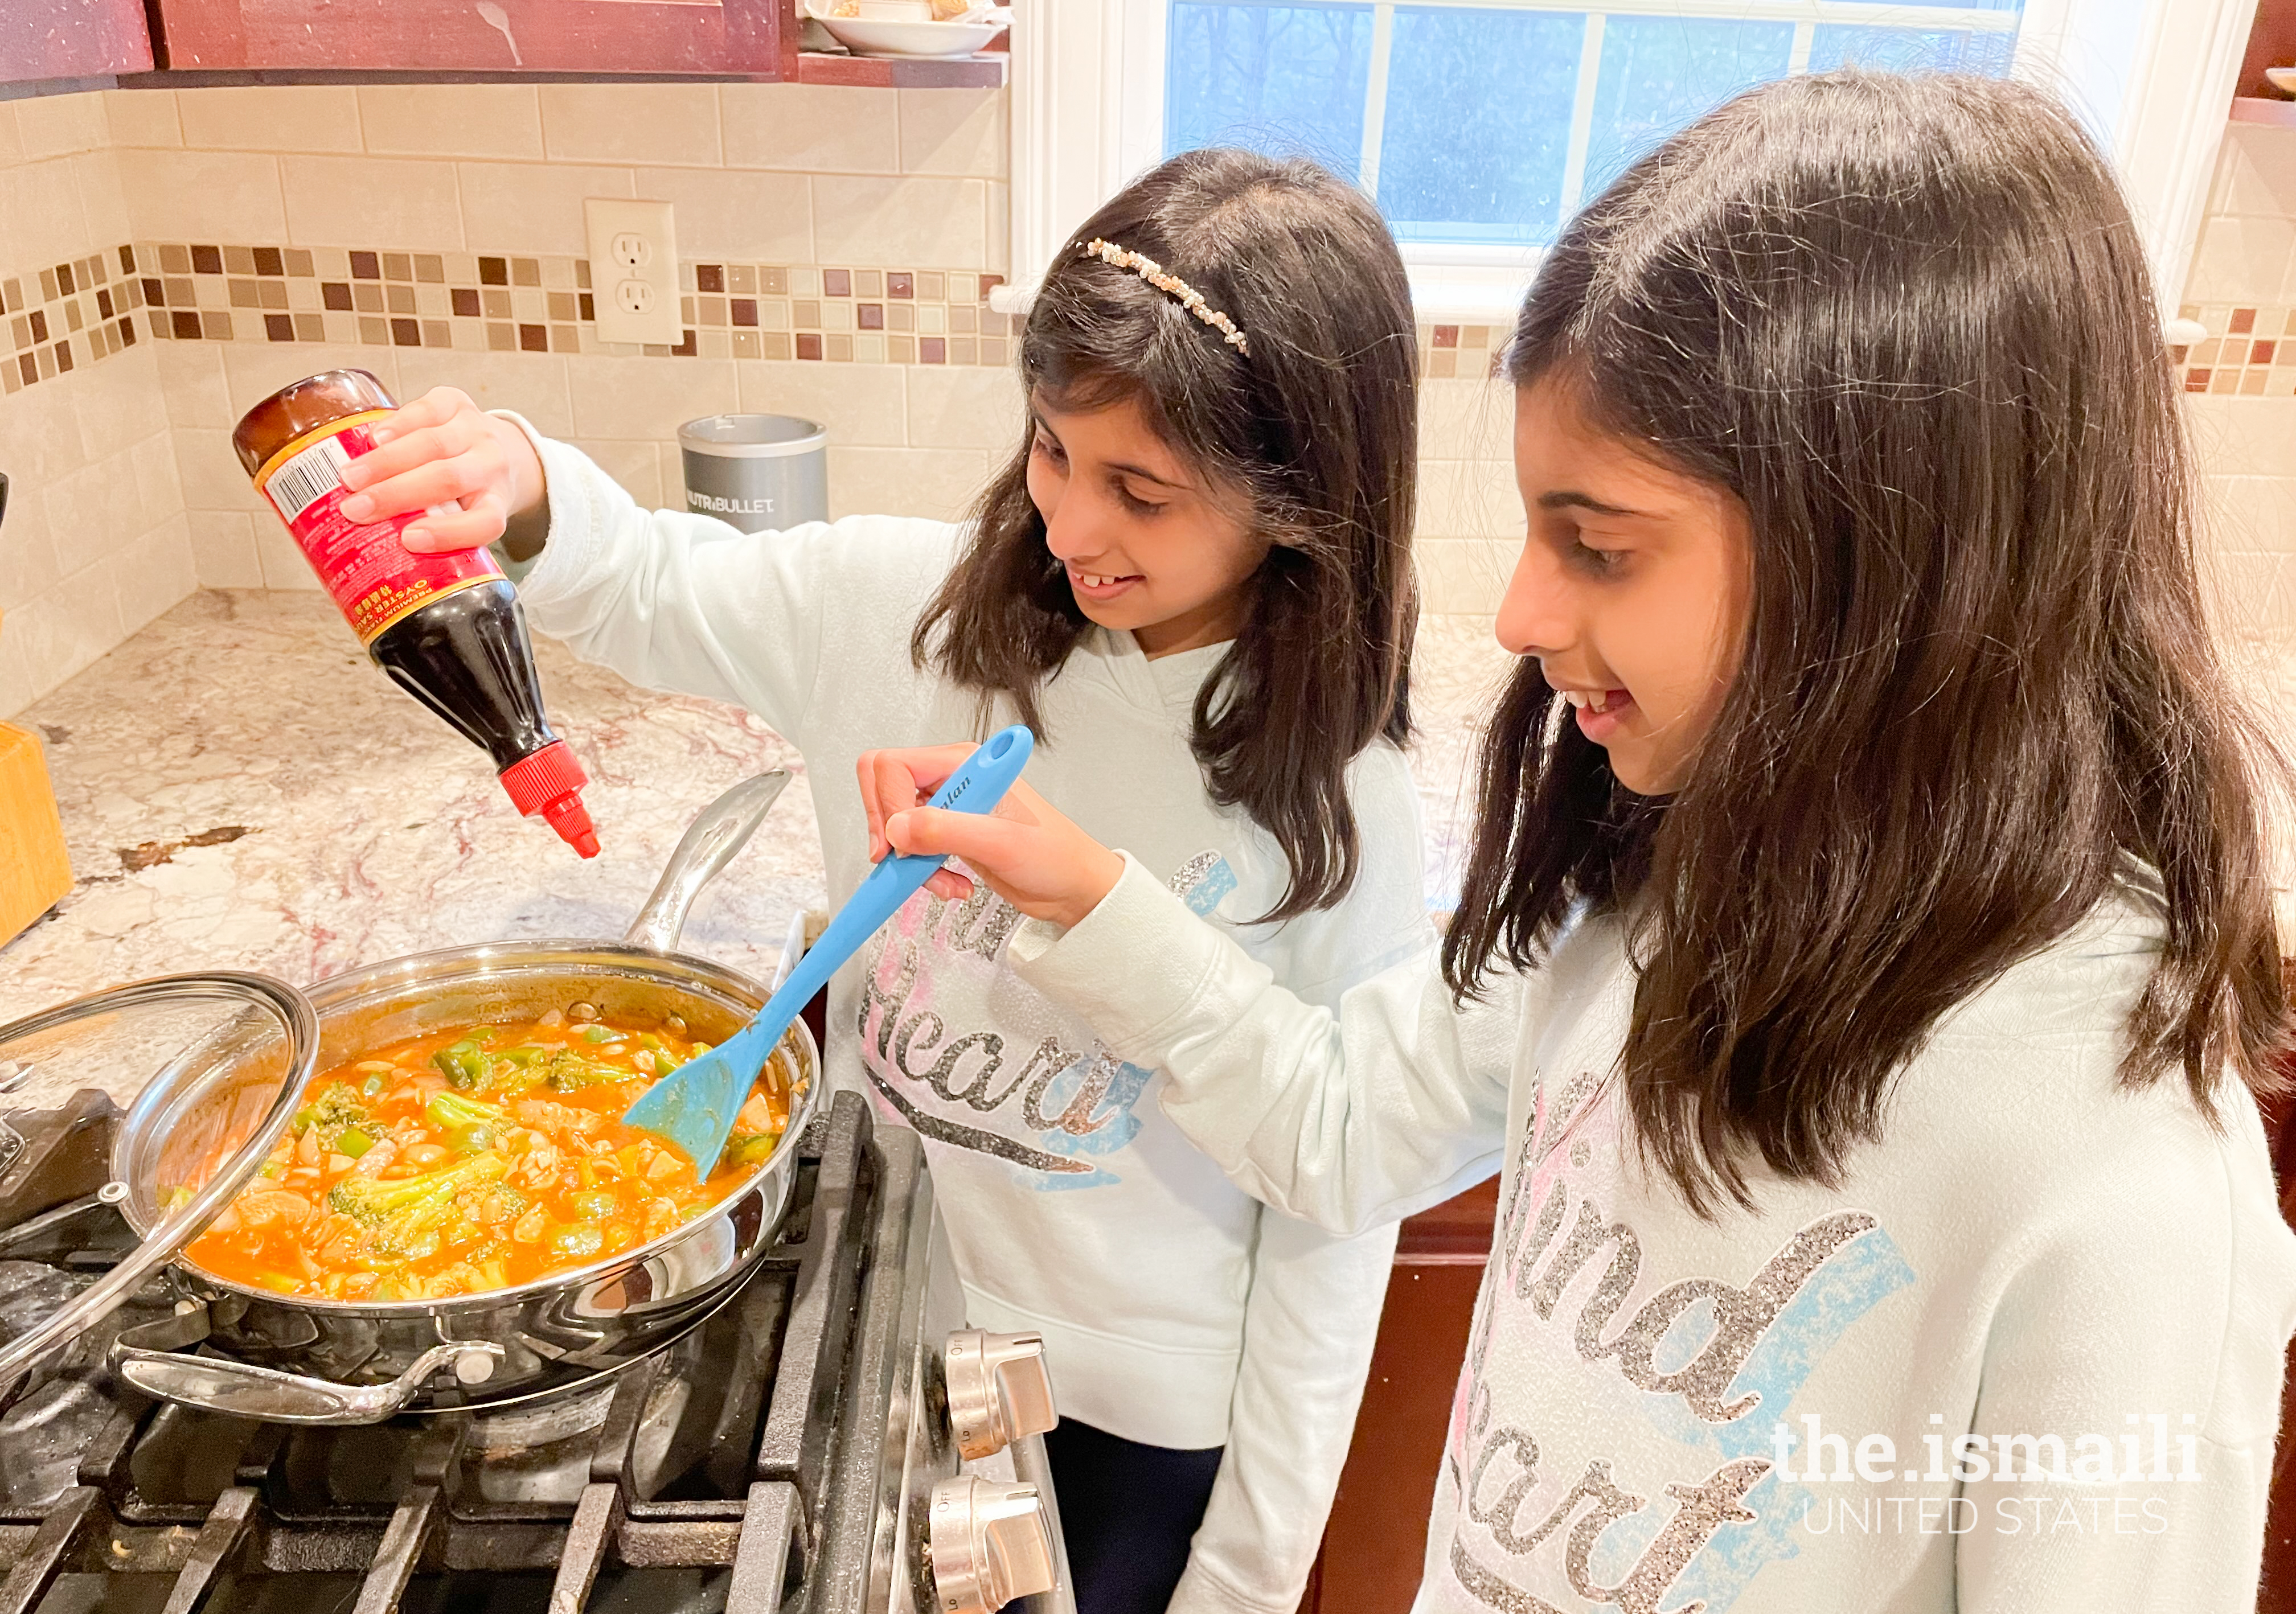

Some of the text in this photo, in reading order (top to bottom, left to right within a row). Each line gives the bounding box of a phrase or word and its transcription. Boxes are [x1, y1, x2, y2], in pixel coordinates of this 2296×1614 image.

[374, 580, 428, 613] OYSTER
[384, 588, 433, 617] PREMIUM
[950, 1339, 964, 1356] OFF
[937, 1492, 951, 1512] OFF
